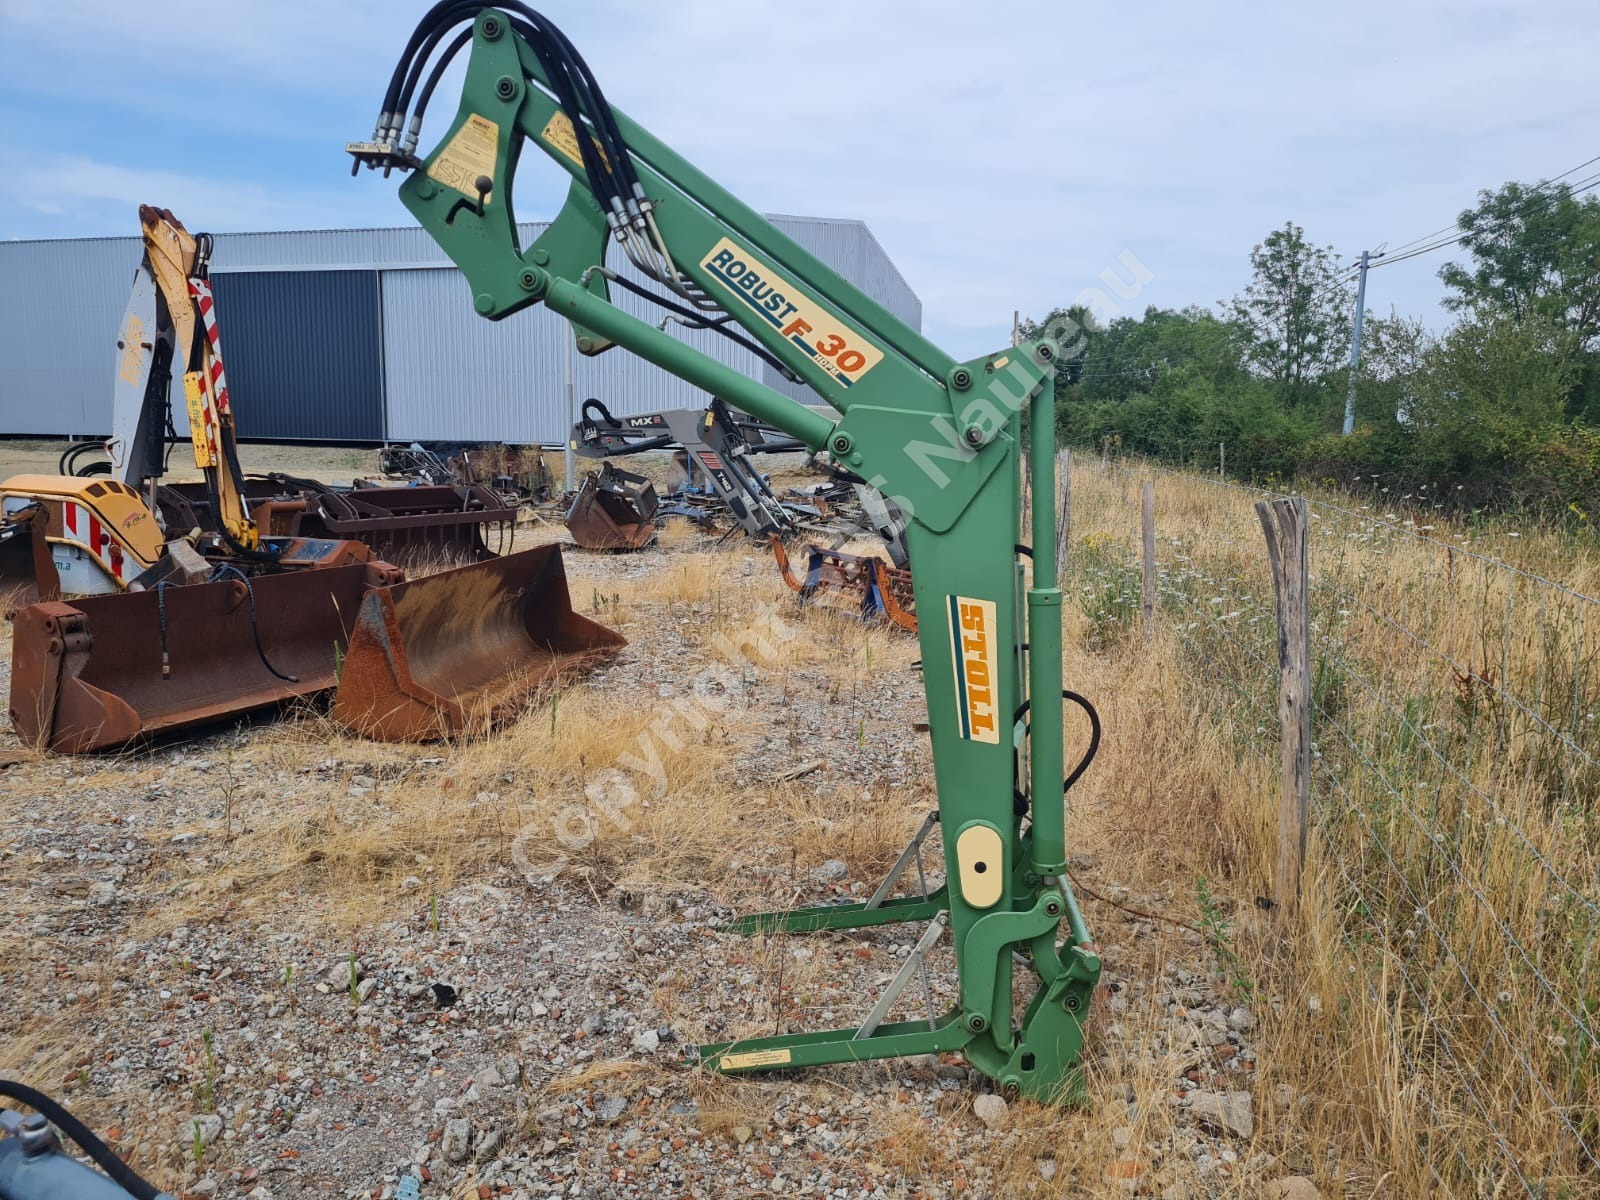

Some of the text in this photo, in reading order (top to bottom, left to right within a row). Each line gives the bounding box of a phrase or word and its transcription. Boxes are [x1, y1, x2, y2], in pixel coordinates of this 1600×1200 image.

[711, 249, 866, 372] ROBUST F 30
[631, 417, 653, 427] MX
[960, 603, 994, 736] STOLL
